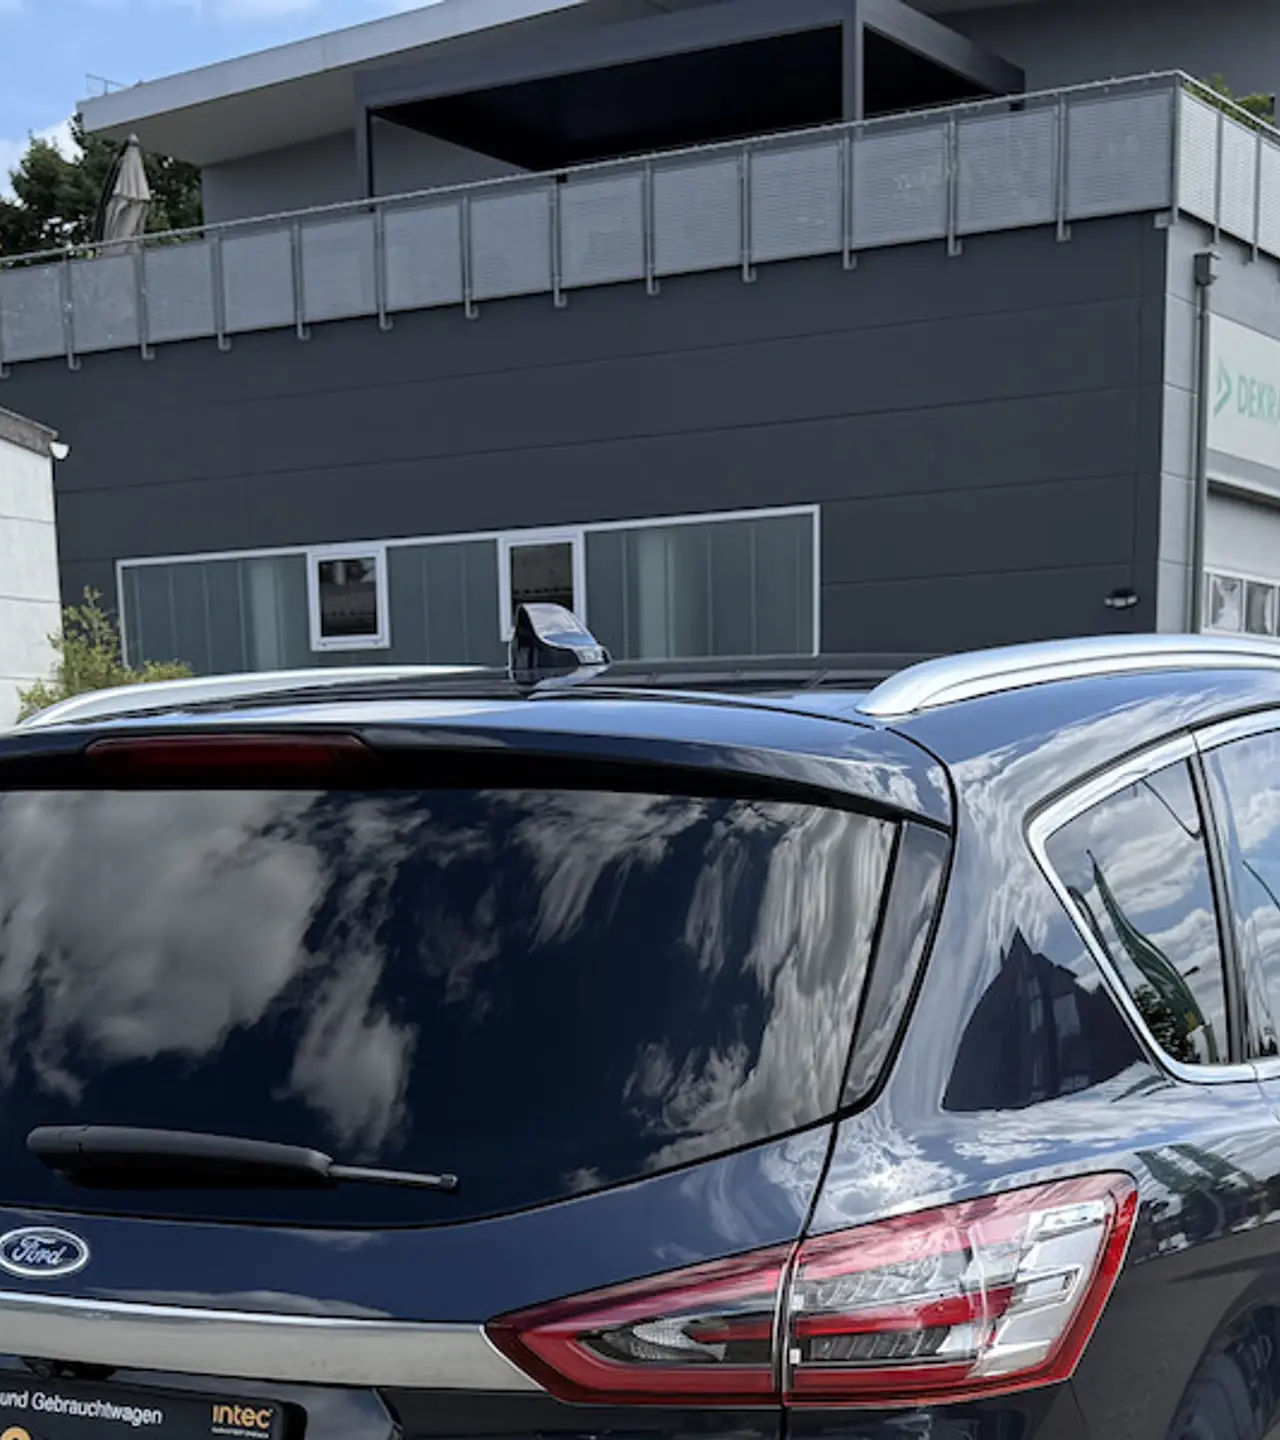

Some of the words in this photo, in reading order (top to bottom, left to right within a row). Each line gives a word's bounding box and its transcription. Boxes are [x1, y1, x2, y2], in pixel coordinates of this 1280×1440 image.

[10, 1235, 68, 1267] Ford
[0, 1390, 29, 1408] und
[31, 1391, 163, 1427] Gebrauchtwagen
